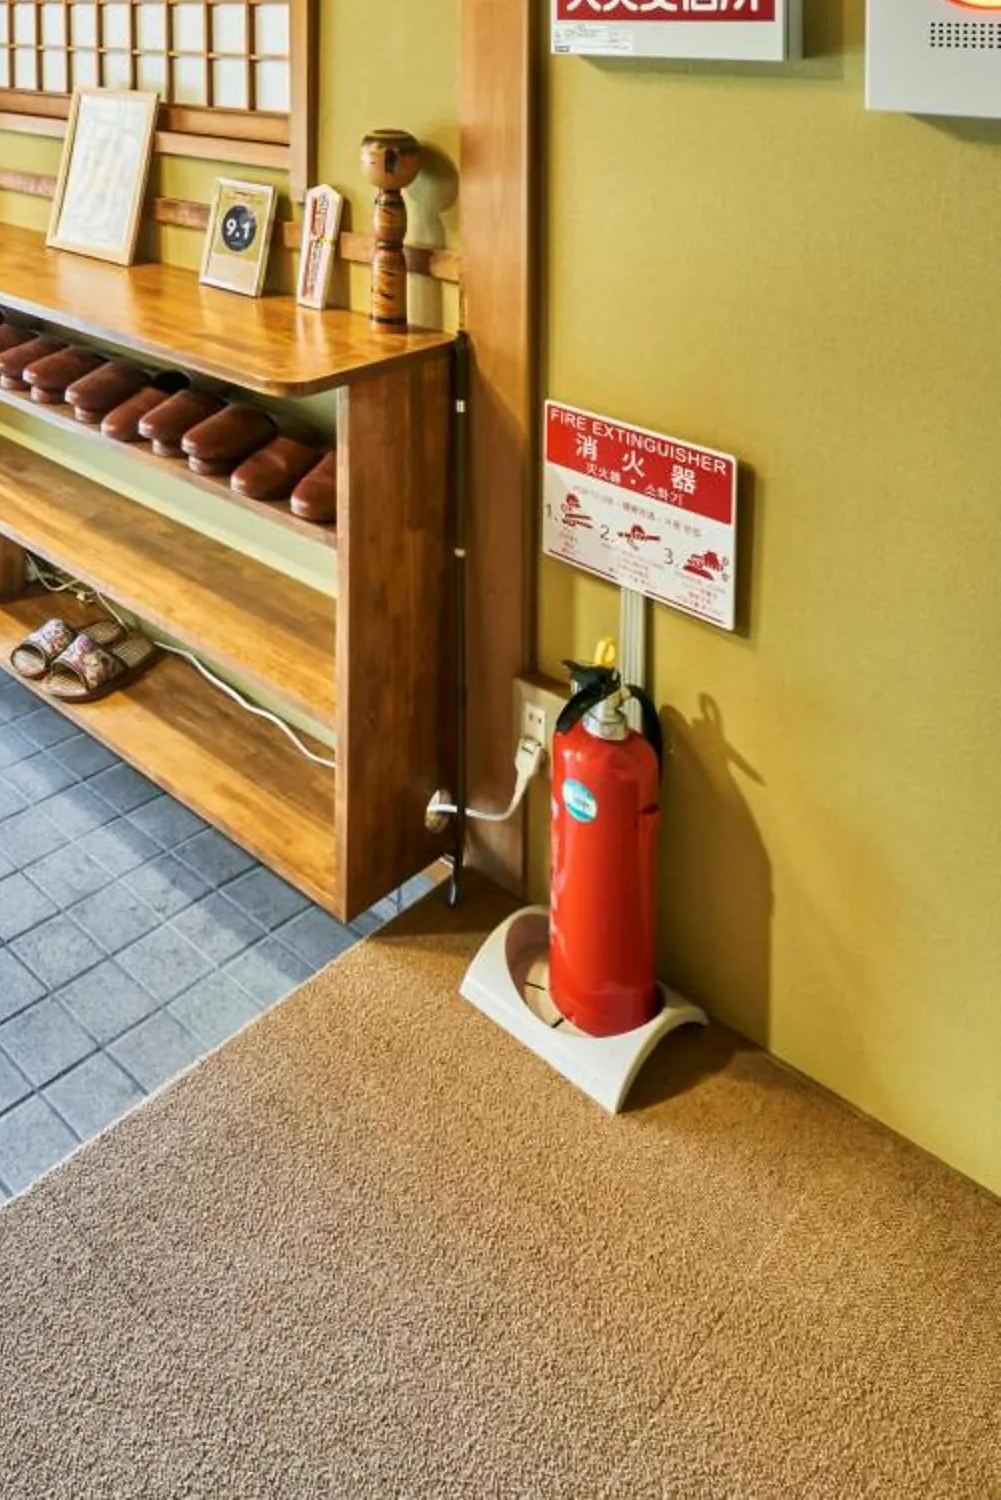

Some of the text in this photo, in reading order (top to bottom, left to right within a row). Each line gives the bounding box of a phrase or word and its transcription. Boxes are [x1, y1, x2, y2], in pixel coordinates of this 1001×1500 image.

[226, 218, 250, 240] 9.1
[550, 406, 727, 476] FIRE EXTINGUISHER
[575, 433, 695, 494] 消火器
